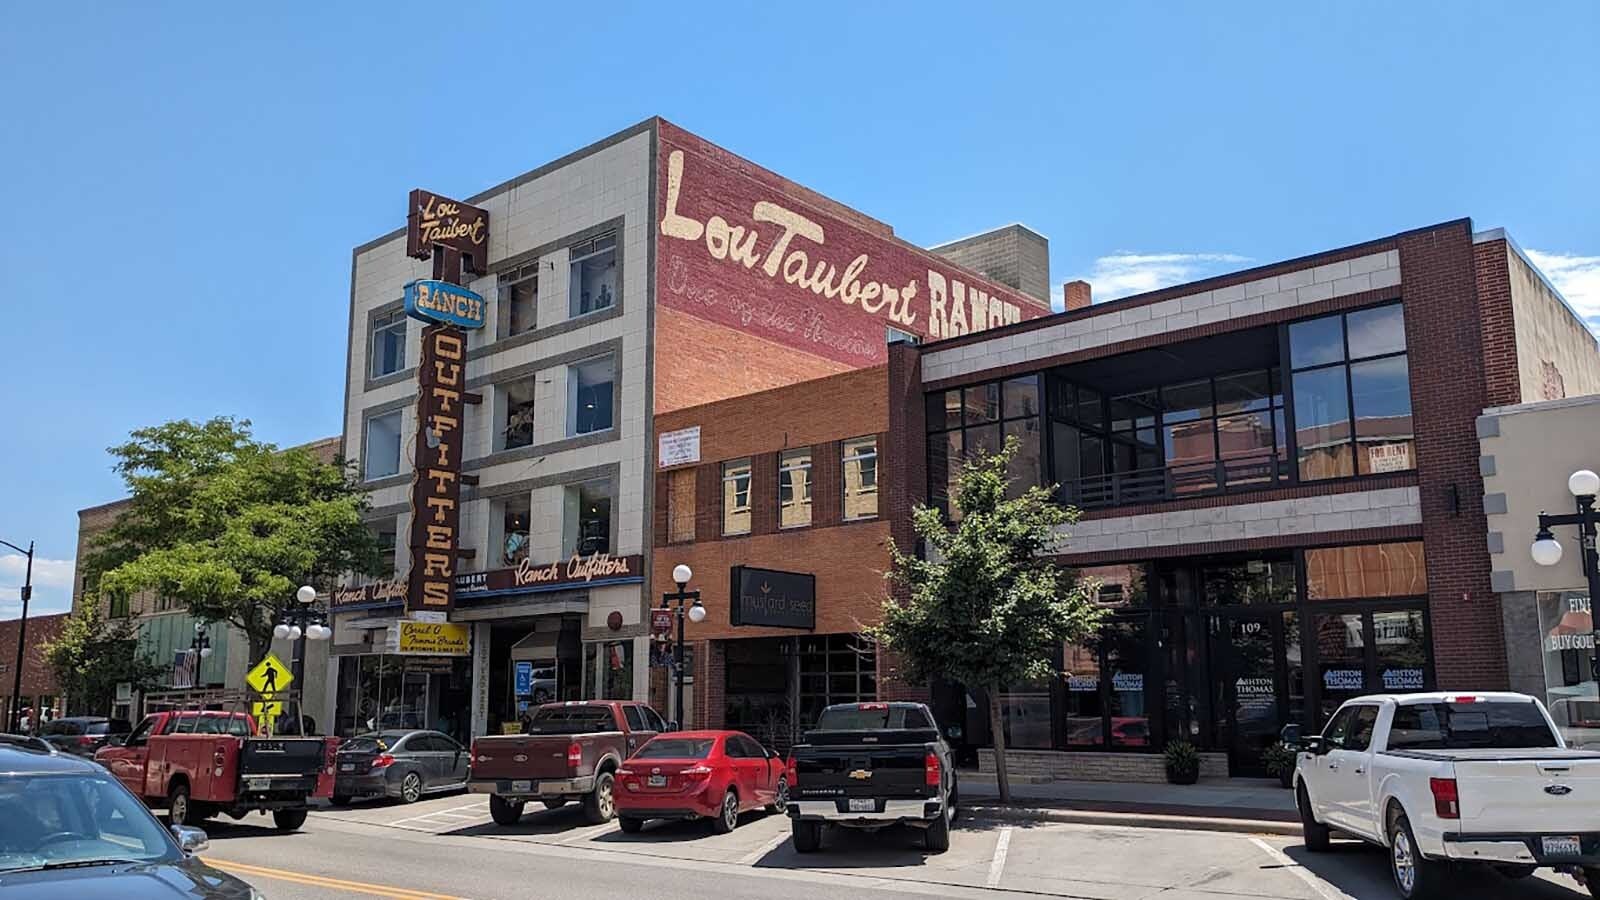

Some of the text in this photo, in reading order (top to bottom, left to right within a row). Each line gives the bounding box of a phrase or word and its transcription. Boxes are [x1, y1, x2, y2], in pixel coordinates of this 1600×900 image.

[420, 195, 485, 245] Lou Taubert
[660, 149, 761, 268] Lou
[753, 200, 919, 326] Taubert
[418, 284, 481, 321] RANCH
[423, 333, 463, 606] OUTFITTERS
[514, 550, 630, 586] Ranch Outfitters
[334, 582, 367, 605] Ranch
[1241, 622, 1261, 633] 109
[1551, 635, 1571, 650] BUY
[1324, 669, 1362, 677] ASHTON
[1382, 668, 1423, 677] ASHTON
[1112, 680, 1144, 688] THOMAS
[1235, 677, 1273, 685] ASHTON
[1325, 677, 1362, 685] THOMAS
[1383, 677, 1423, 685] THOMAS
[1236, 685, 1274, 694] THOMAS
